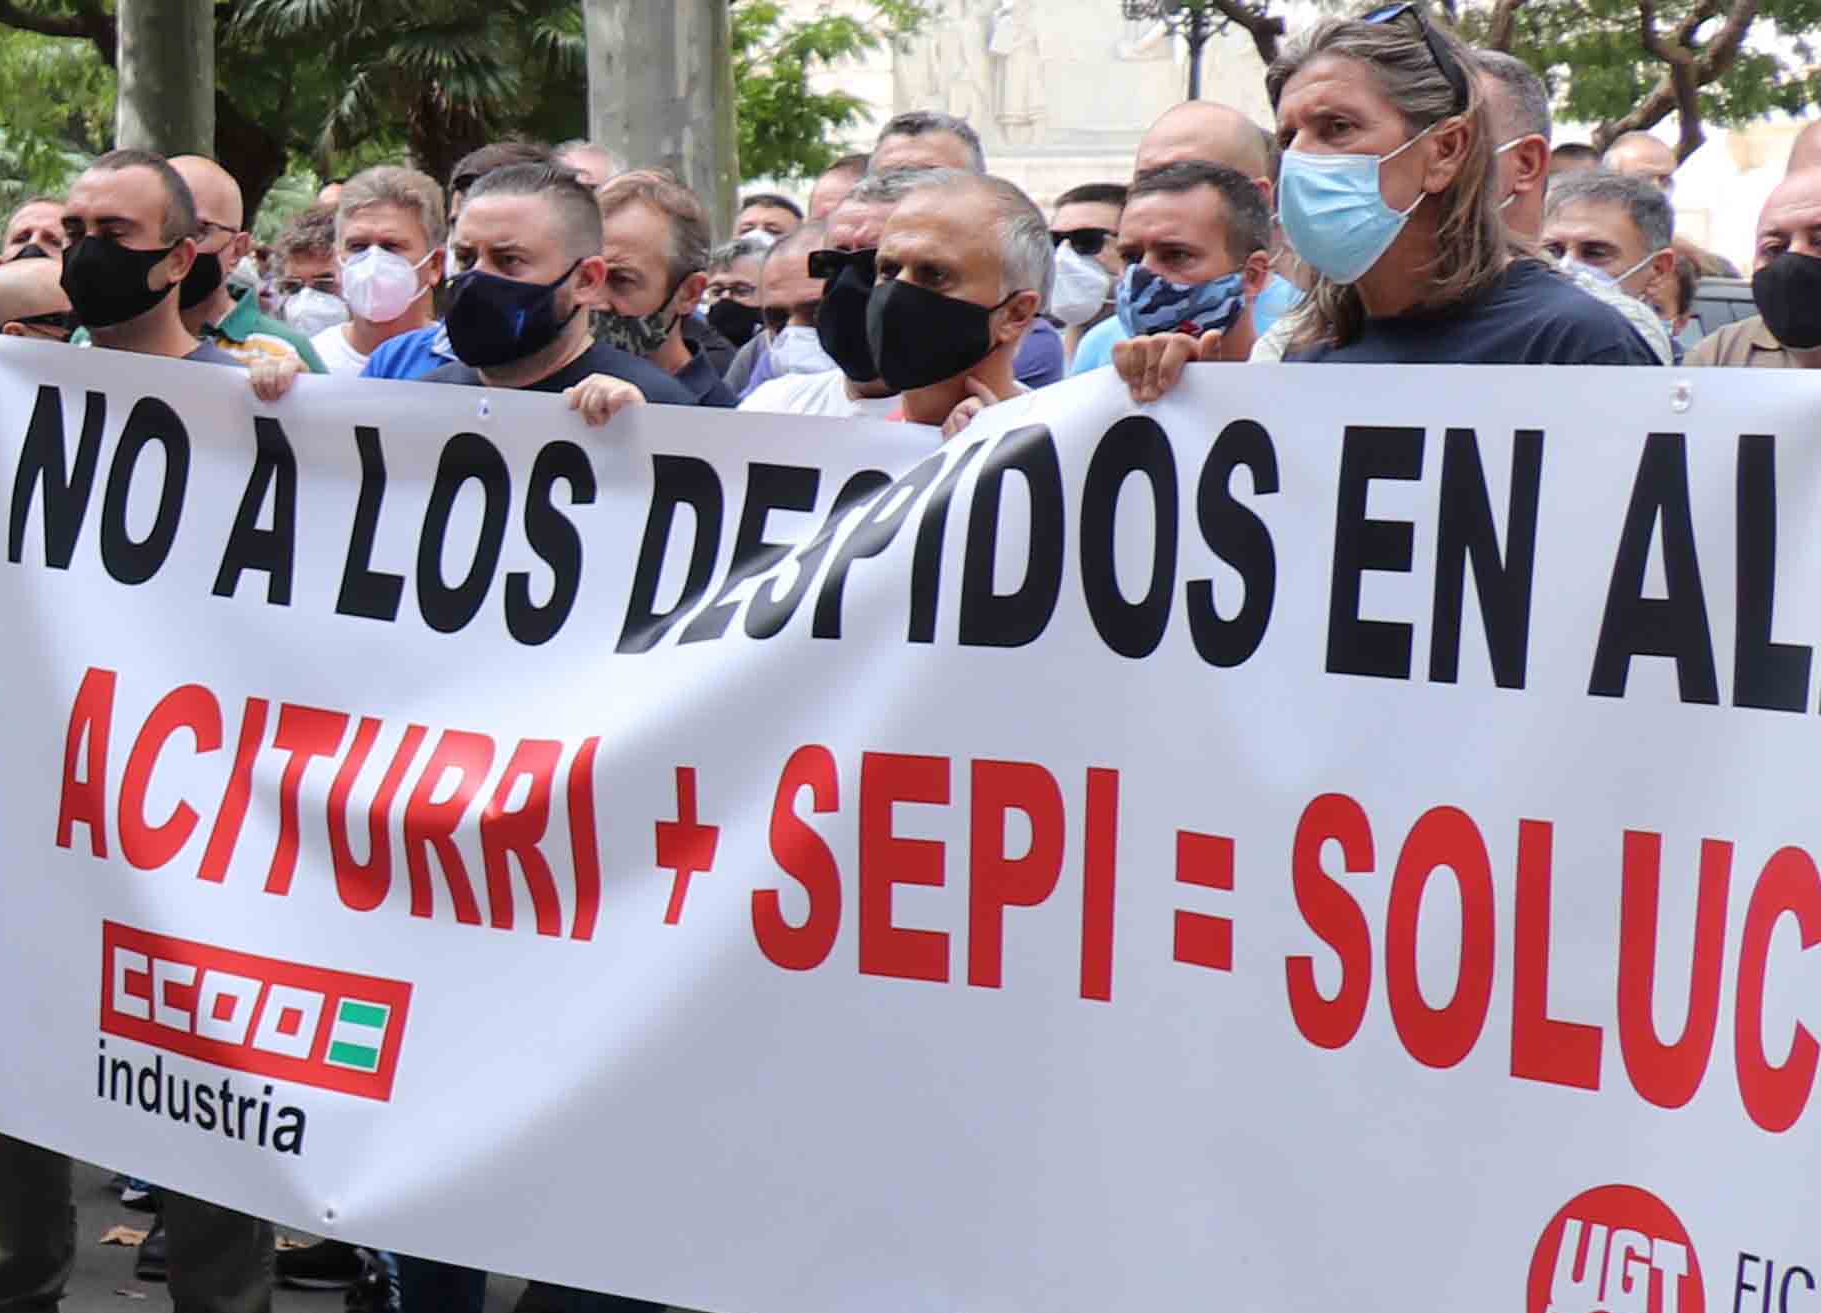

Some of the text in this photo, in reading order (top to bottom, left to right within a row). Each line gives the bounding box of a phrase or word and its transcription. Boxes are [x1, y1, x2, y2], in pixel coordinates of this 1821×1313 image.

[8, 384, 1821, 716] NO A LOS DESPIDOS EN AL
[55, 666, 602, 942] ACITURRI
[751, 744, 1120, 1003] SEPI
[97, 1040, 308, 1156] industria
